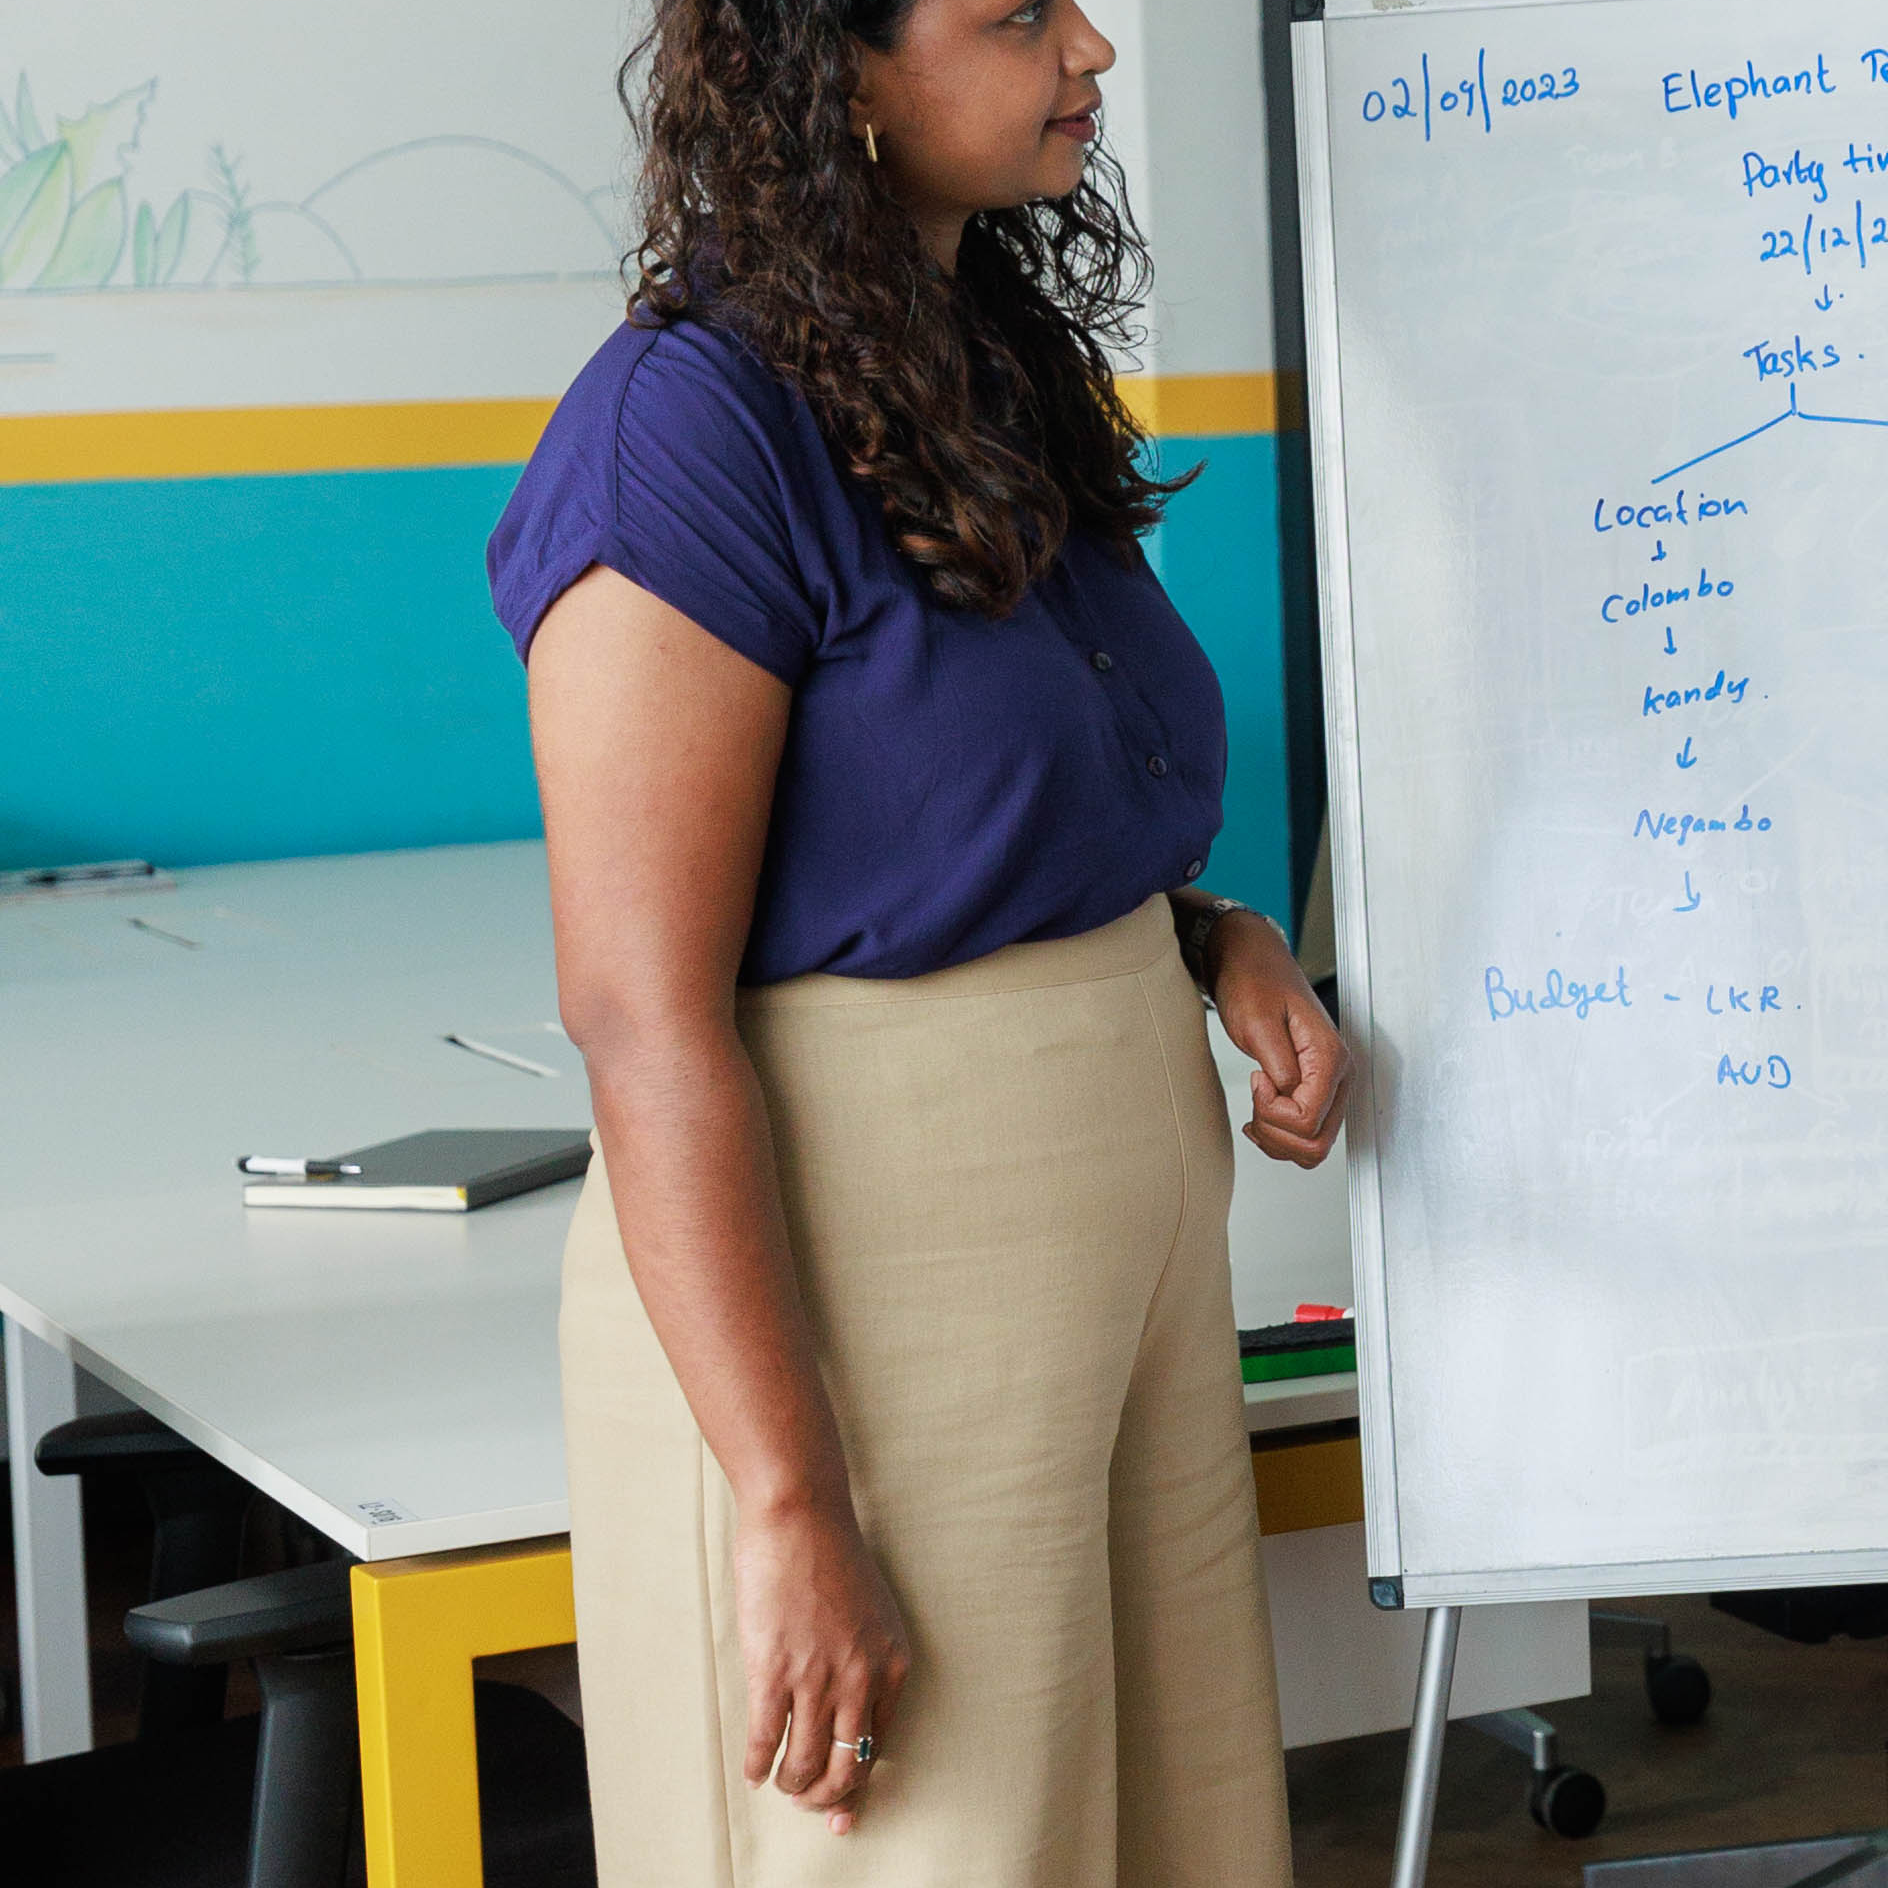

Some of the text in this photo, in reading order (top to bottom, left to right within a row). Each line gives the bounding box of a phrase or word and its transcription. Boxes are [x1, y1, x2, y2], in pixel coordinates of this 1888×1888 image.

[1363, 48, 1580, 141] 02/09/2023
[1662, 53, 1836, 120] Elephant
[1743, 149, 1828, 203] Party
[1594, 489, 1748, 532] Location
[1602, 568, 1734, 623] Colombo
[1485, 966, 1632, 1021] Budget
[1718, 1054, 1791, 1089] AUD
